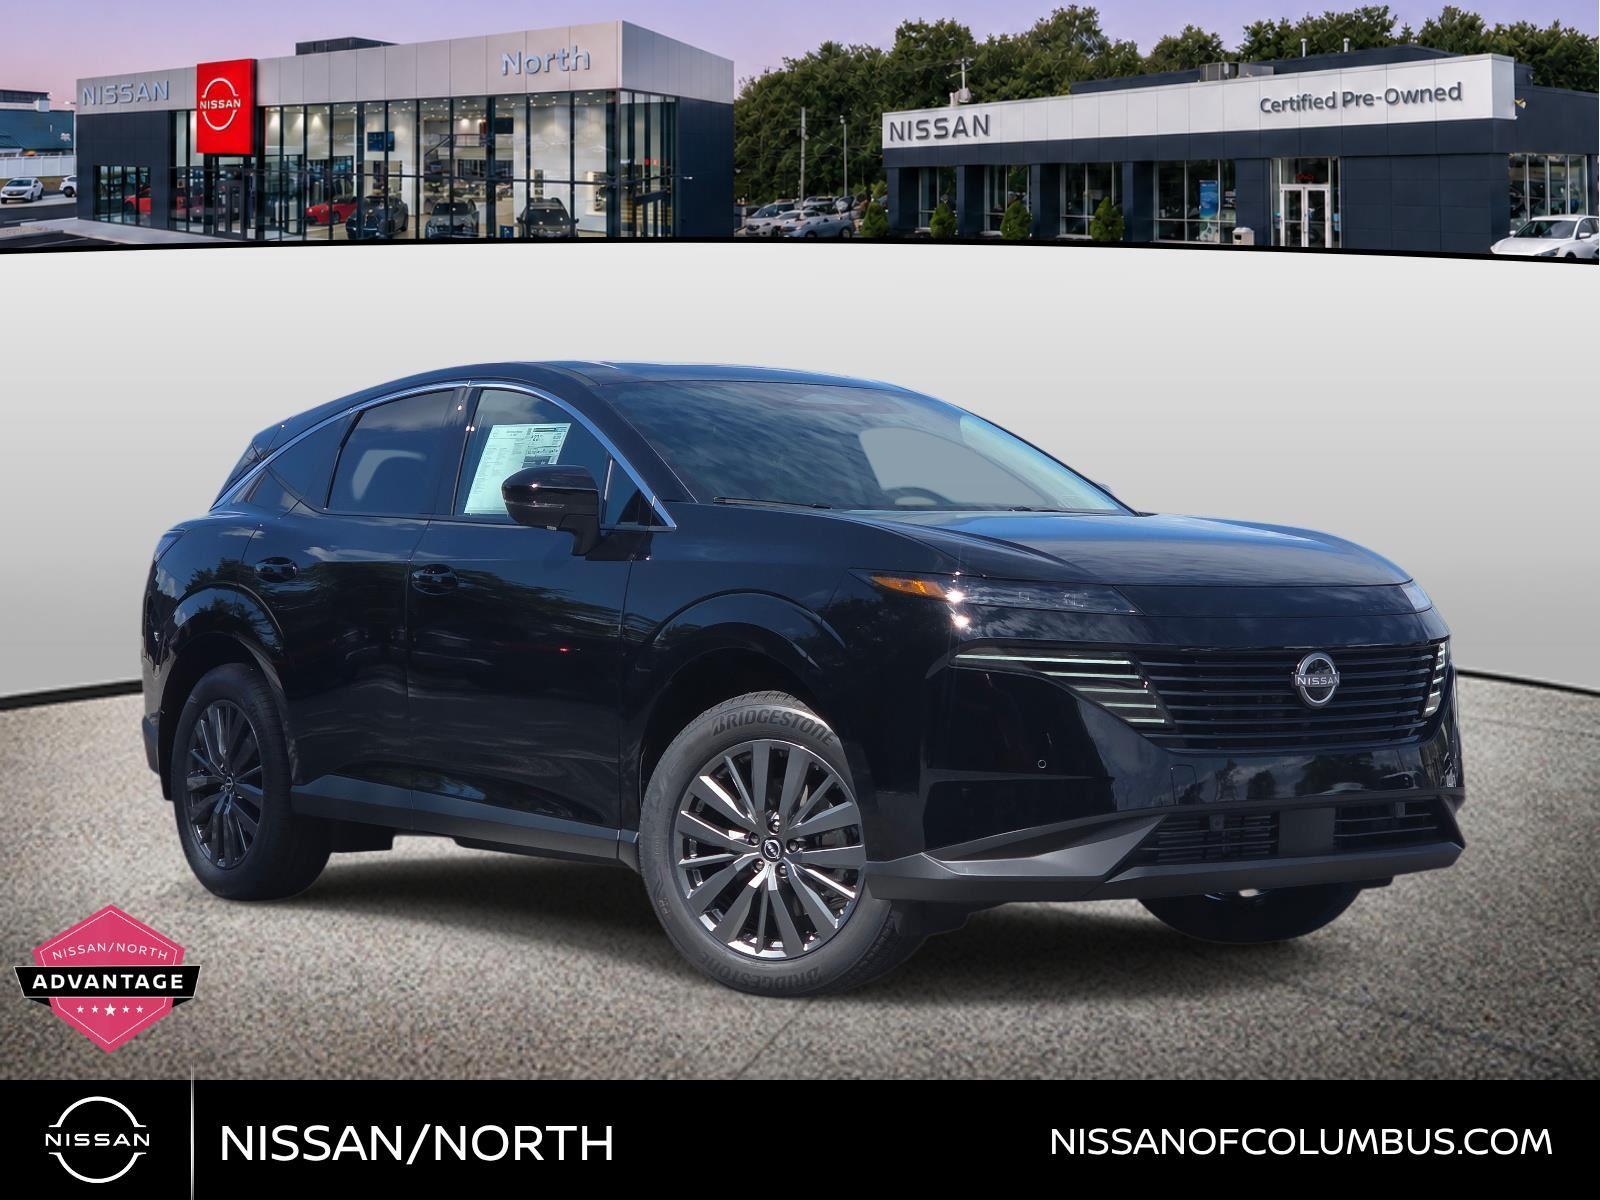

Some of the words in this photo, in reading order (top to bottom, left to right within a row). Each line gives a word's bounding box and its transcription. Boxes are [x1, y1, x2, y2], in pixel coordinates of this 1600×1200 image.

[501, 45, 590, 76] North
[82, 80, 169, 106] NISSAN
[199, 98, 241, 110] NISSAN
[1260, 90, 1337, 114] Certified
[1342, 82, 1463, 109] Pre-Owned
[889, 114, 991, 142] NISSAN
[1297, 676, 1340, 686] NISSAN
[711, 708, 836, 746] BRIDGESTONE
